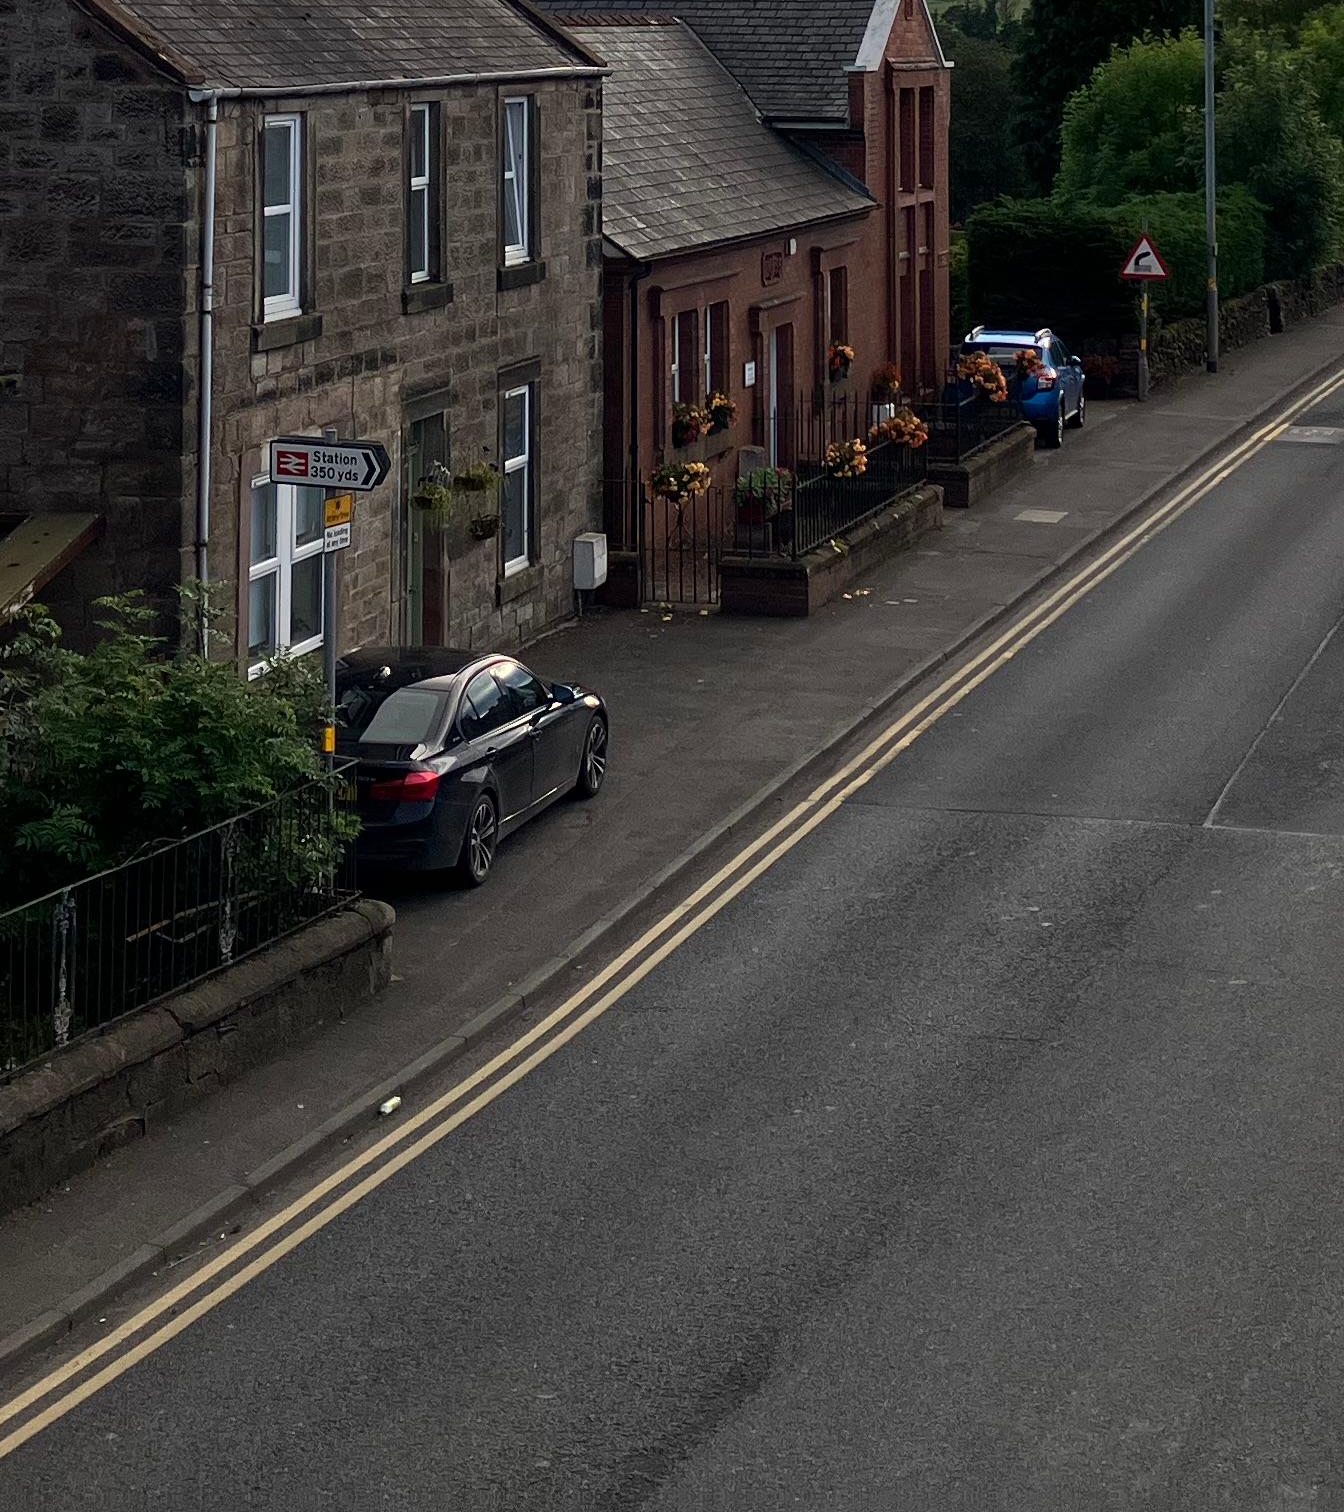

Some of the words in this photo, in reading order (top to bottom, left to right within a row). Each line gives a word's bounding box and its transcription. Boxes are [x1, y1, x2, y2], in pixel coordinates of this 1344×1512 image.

[313, 450, 358, 466] Station
[310, 465, 336, 479] 350
[337, 470, 359, 483] yds
